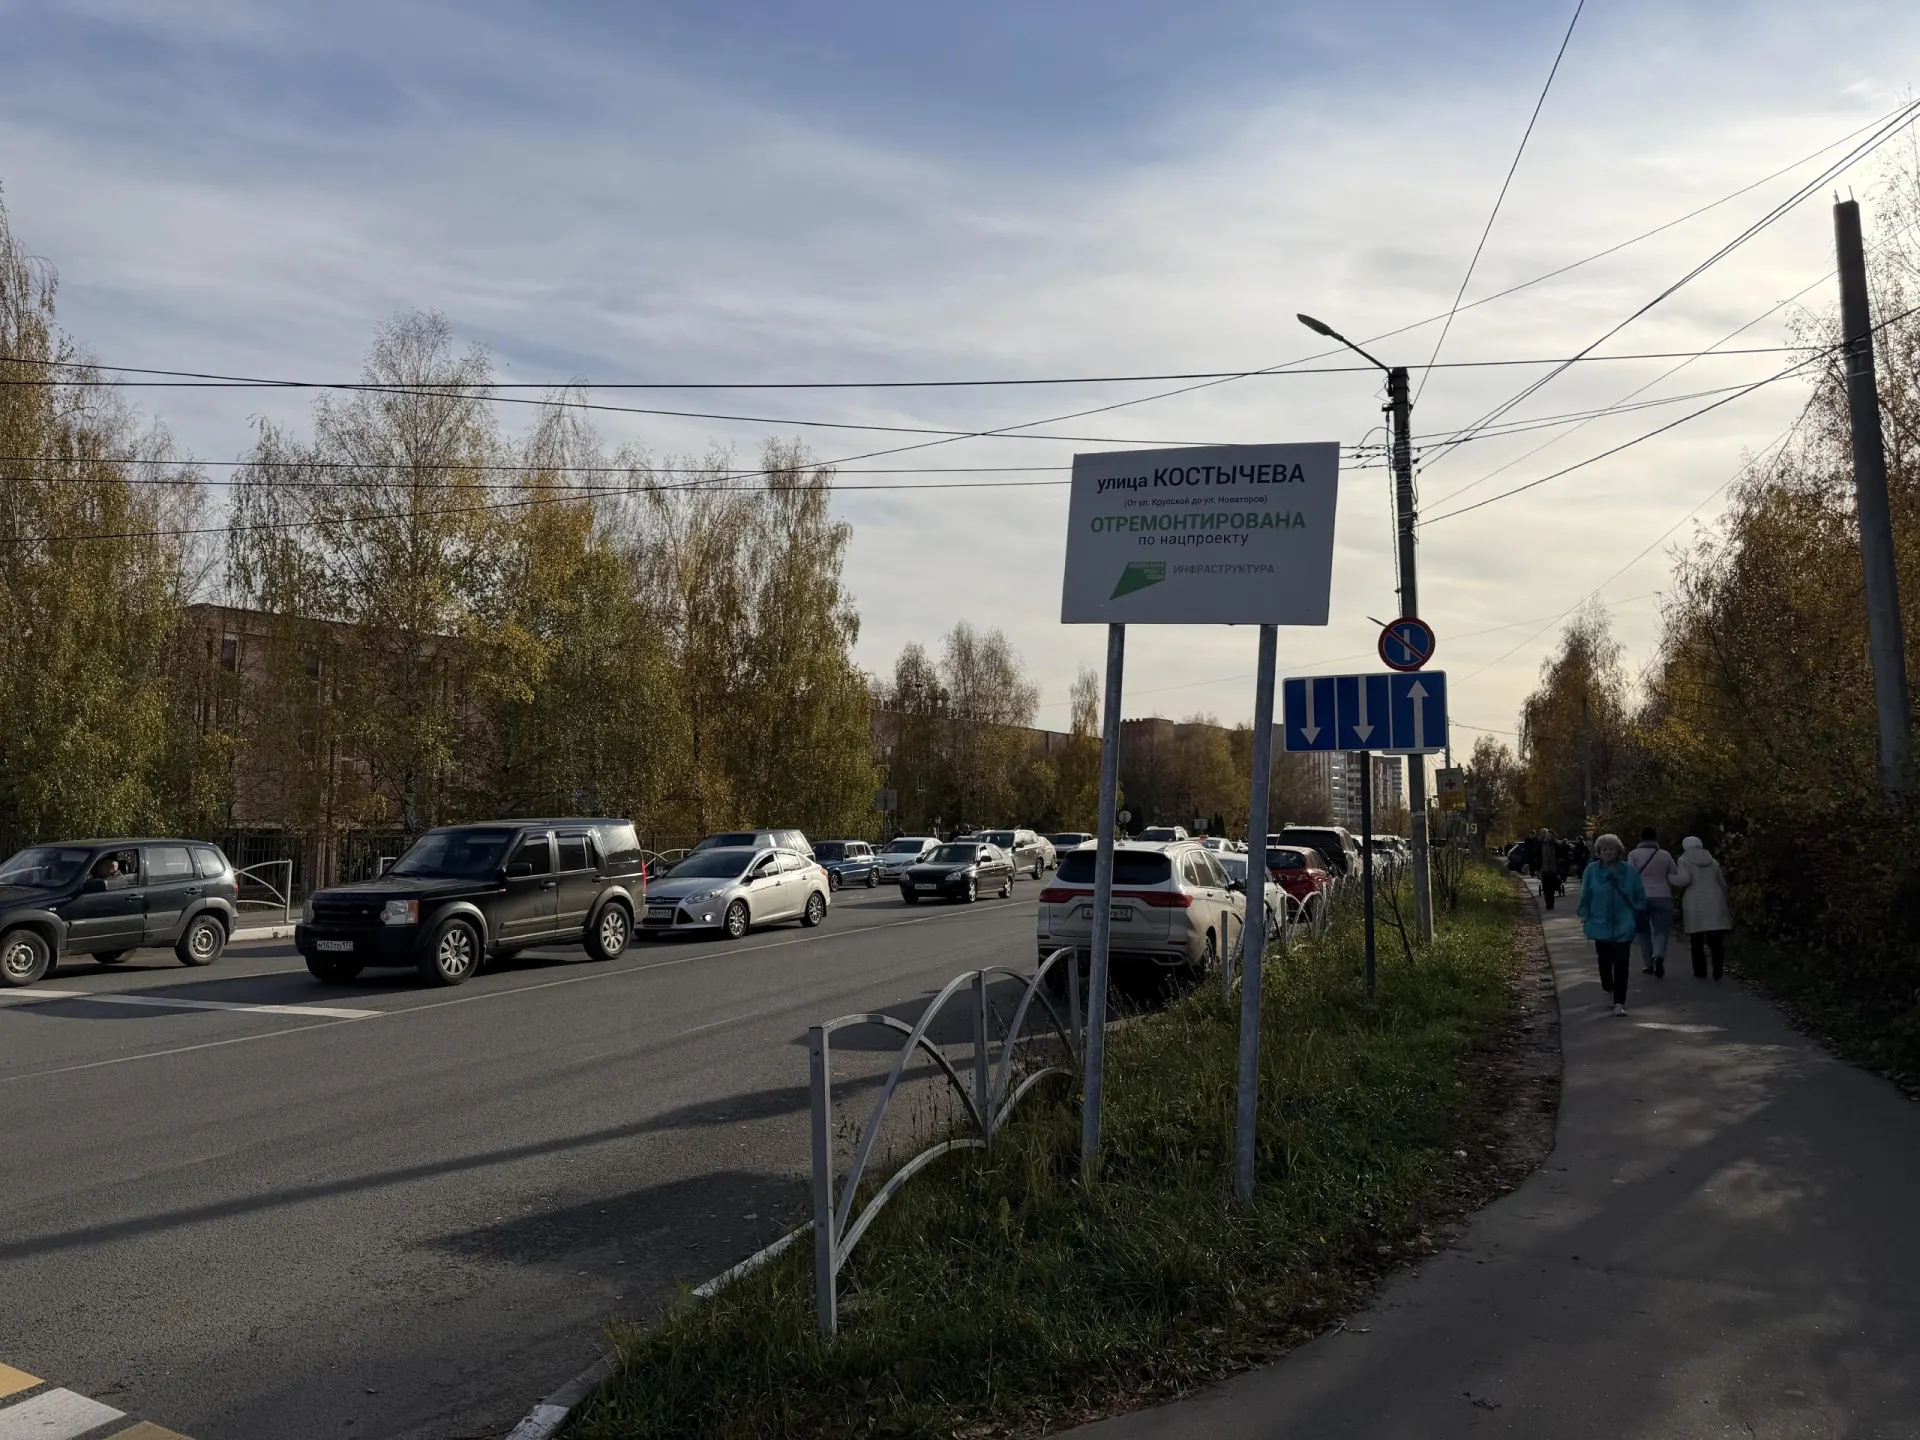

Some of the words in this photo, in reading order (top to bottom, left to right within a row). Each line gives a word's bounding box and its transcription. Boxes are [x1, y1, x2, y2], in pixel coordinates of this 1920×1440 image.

[1097, 474, 1148, 494] улица
[1153, 463, 1305, 487] КОСТЫЧЕВА
[1124, 499, 1138, 508] (От
[1138, 500, 1150, 508] ул.
[1151, 497, 1190, 507] Крупской
[1191, 497, 1202, 505] до
[1218, 495, 1268, 504] Новаторов)
[1090, 511, 1306, 533] ОТРЕМОНТИРОВАНА
[1138, 536, 1155, 545] по
[1160, 534, 1249, 547] нацпроекту
[1173, 564, 1275, 574] ИНФРАСТРУКТУРА
